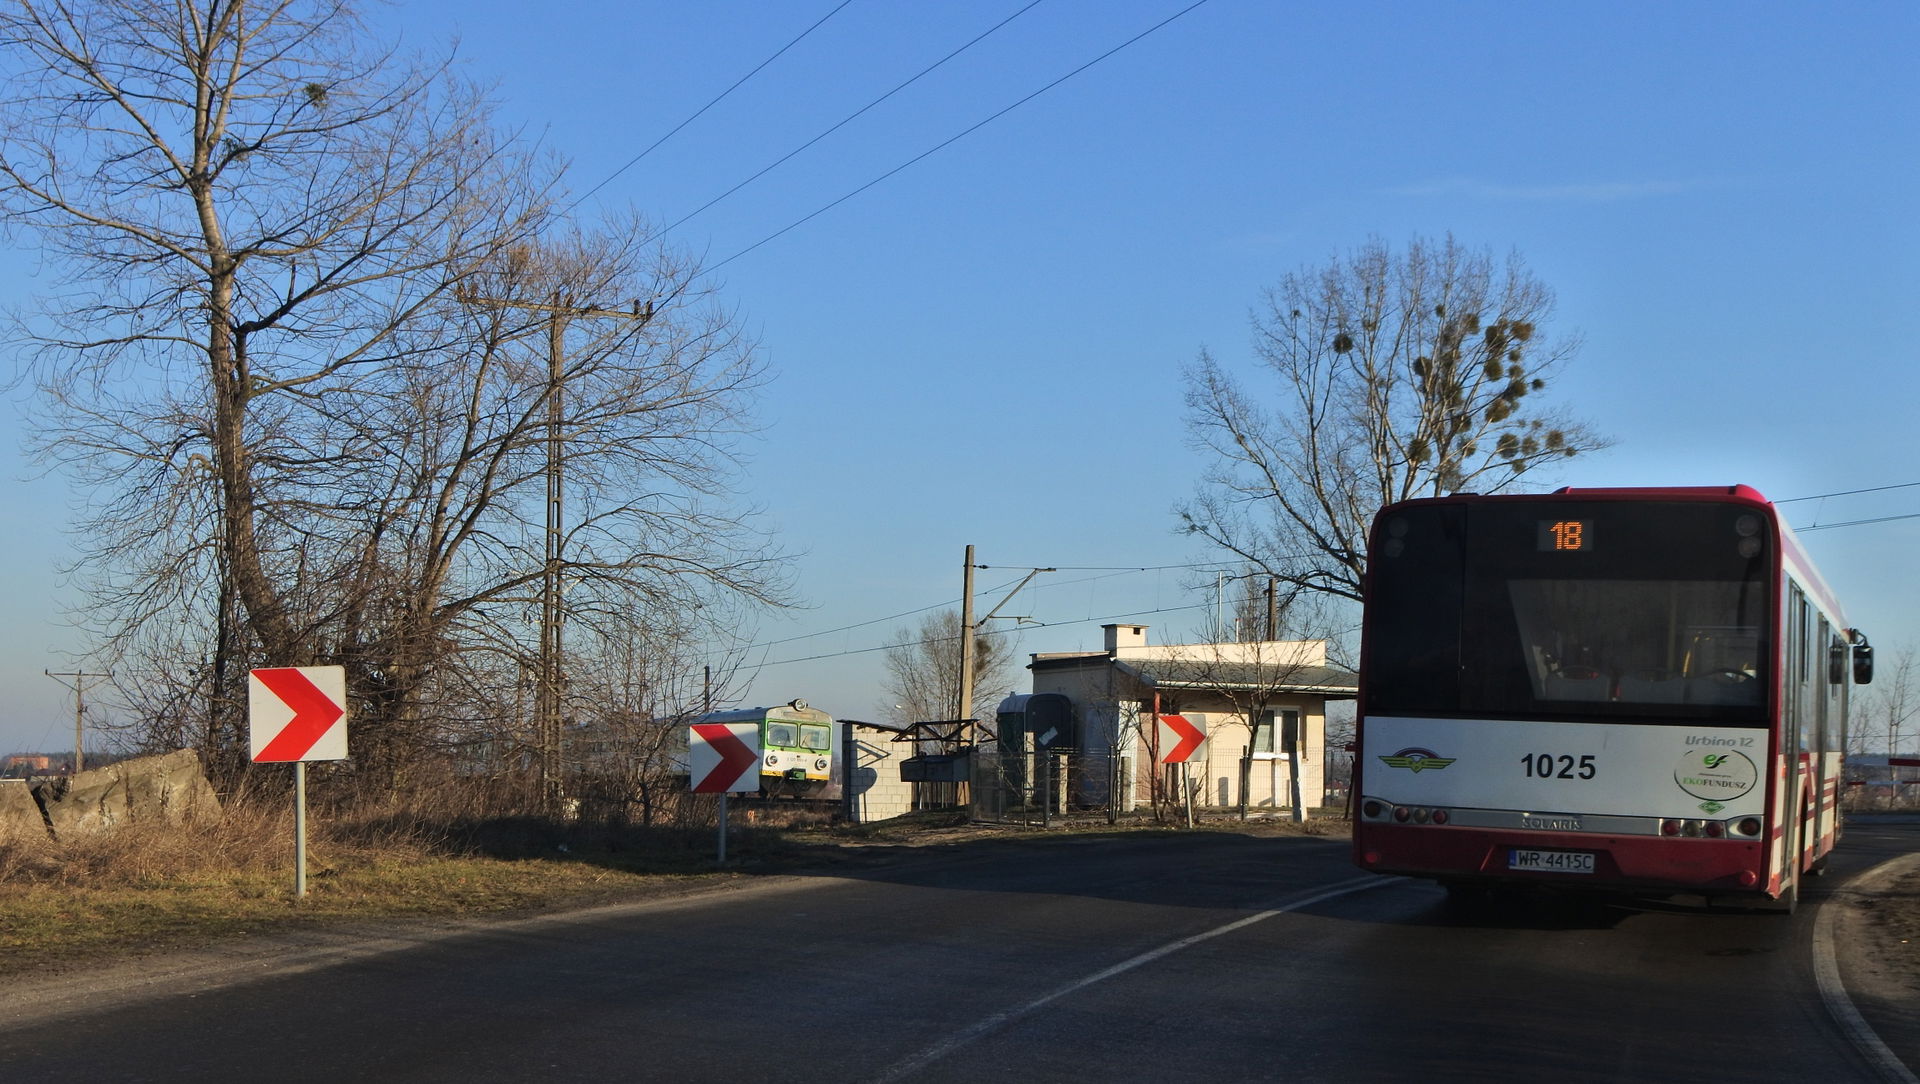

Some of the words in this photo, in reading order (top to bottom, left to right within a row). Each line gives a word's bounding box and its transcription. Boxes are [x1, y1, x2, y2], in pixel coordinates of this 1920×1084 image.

[1549, 521, 1582, 549] 18
[1685, 735, 1736, 747] Urbino
[1738, 737, 1755, 748] 12
[1520, 753, 1596, 780] 1025
[1682, 776, 1747, 789] EKOFUNDUSZ
[1521, 817, 1582, 831] SOLARIS
[1519, 852, 1540, 867] WR
[1545, 854, 1592, 869] 4415C
